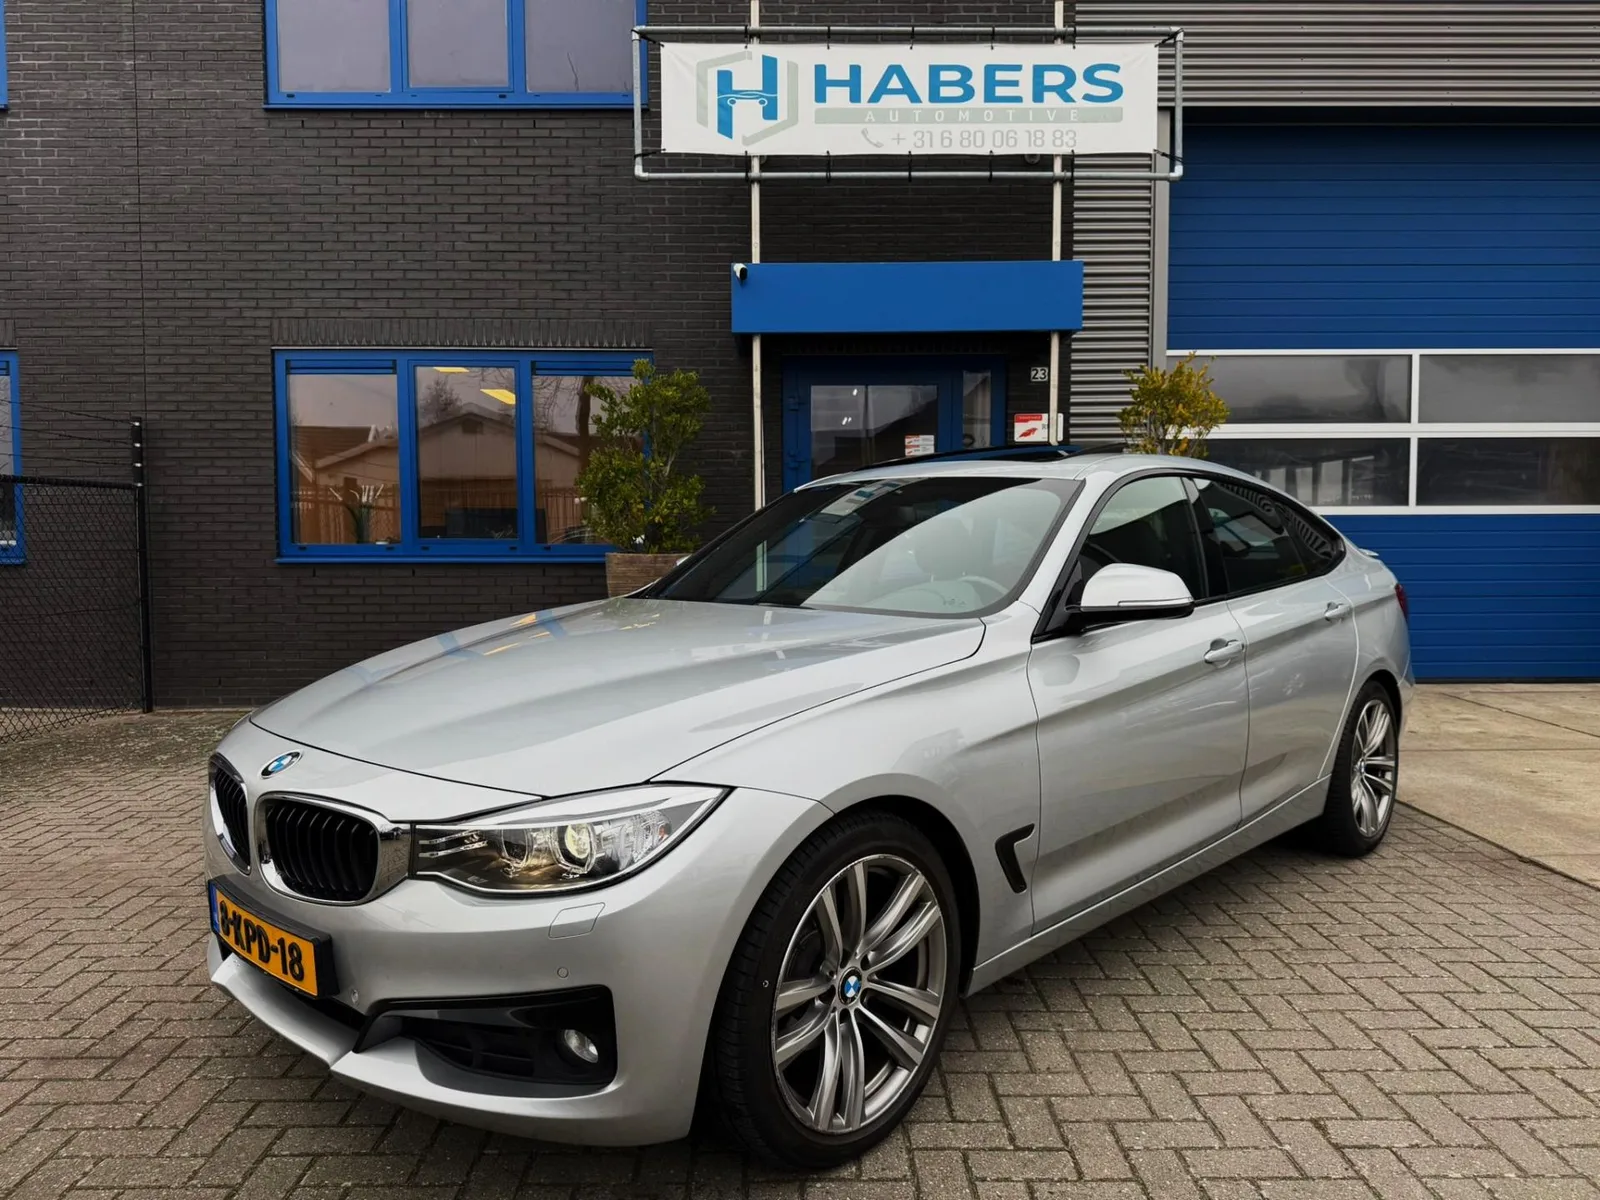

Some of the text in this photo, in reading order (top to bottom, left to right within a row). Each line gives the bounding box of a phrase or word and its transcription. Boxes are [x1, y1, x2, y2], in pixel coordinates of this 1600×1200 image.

[814, 63, 1124, 104] HABERS
[865, 109, 1078, 122] AUTOMOTIVE
[960, 130, 985, 148] 80
[992, 130, 1018, 148] 06
[1025, 130, 1045, 148] 18
[1052, 130, 1077, 148] 83
[1031, 368, 1047, 380] 23
